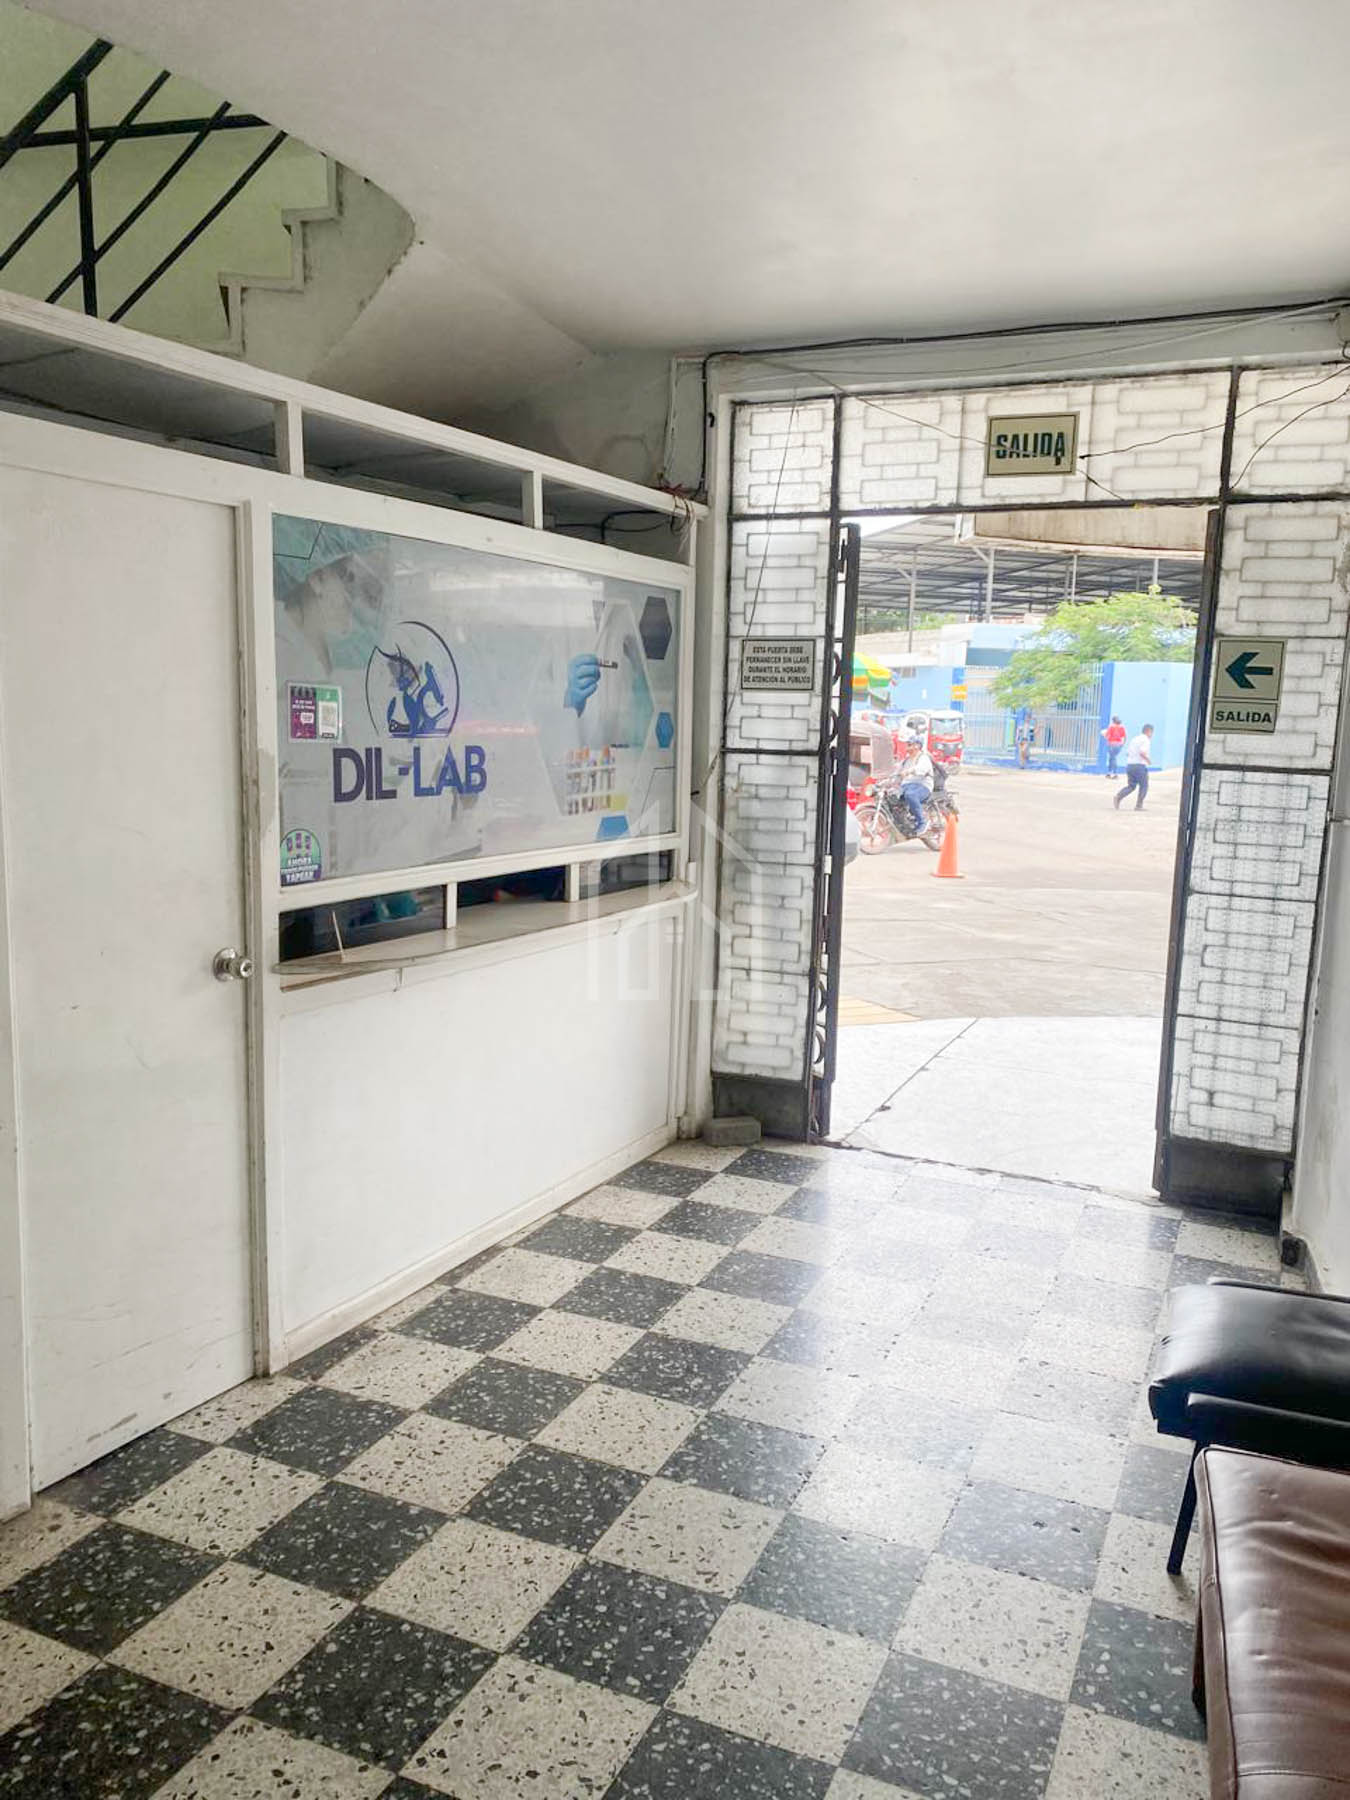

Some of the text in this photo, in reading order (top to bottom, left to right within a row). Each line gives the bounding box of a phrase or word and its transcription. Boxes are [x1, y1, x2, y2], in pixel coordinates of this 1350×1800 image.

[995, 432, 1065, 459] SALIDA
[767, 646, 788, 654] PUERTA
[782, 656, 792, 664] SIN
[793, 656, 810, 664] LLAVE
[782, 666, 807, 674] HORARIO
[1215, 711, 1272, 723] SALIDA
[333, 744, 488, 803] DIL-LAB
